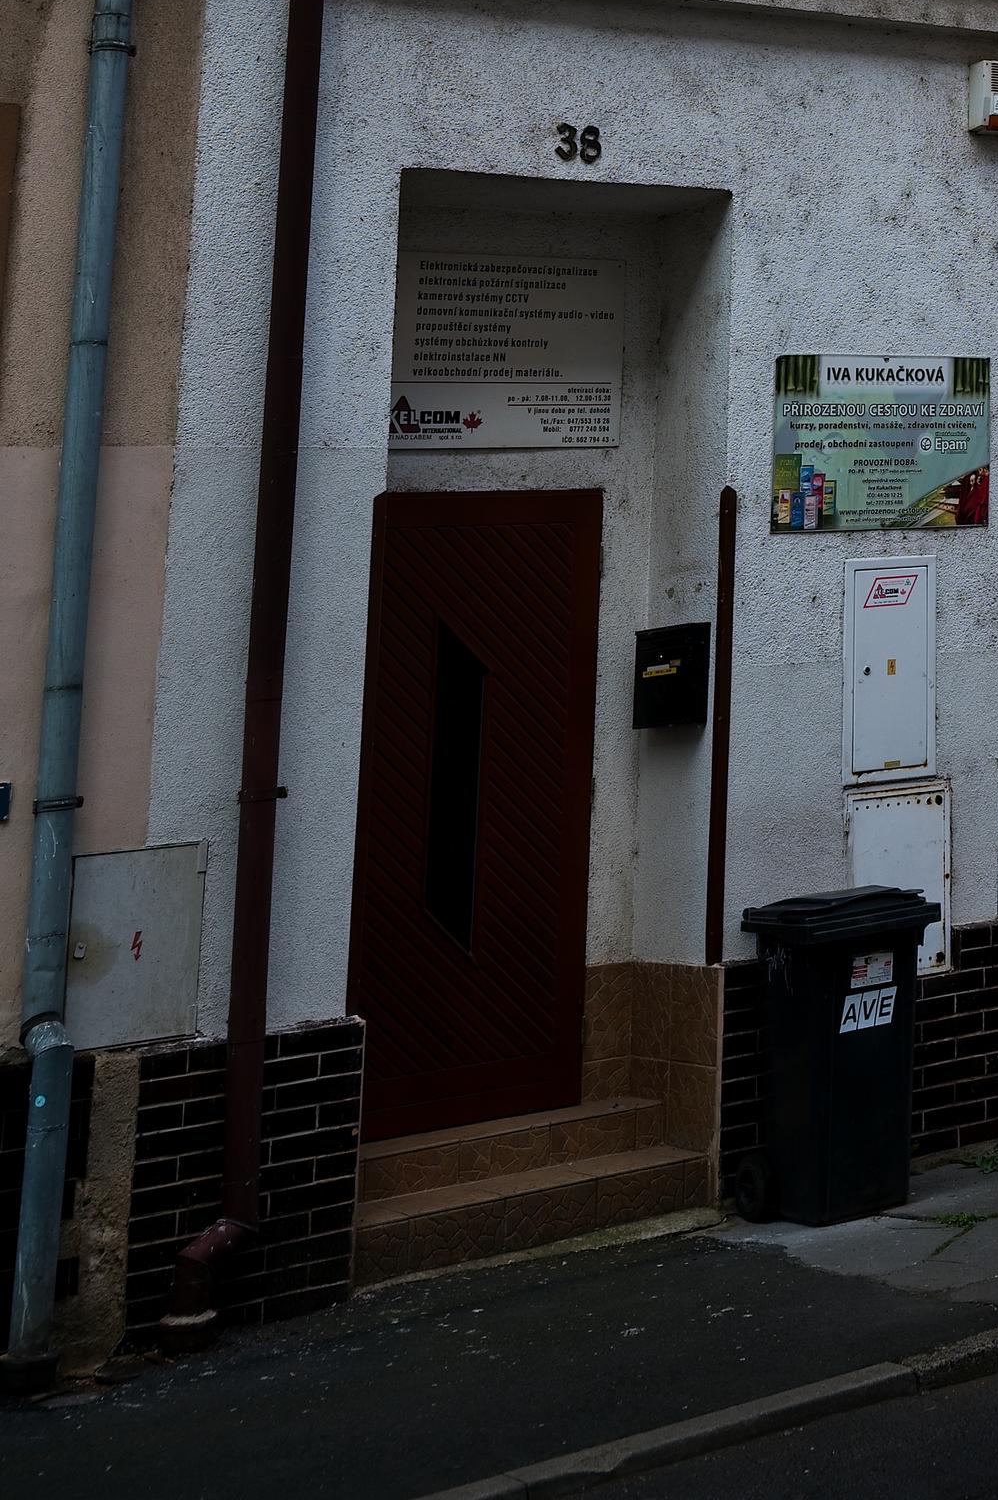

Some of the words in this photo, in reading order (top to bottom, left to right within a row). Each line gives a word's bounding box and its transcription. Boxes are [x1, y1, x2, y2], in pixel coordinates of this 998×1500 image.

[555, 122, 601, 164] 38
[420, 260, 478, 272] Elektronická
[479, 263, 546, 275] zabezpečovací
[547, 266, 598, 277] signalizace
[418, 276, 477, 287] elektronická
[479, 277, 514, 289] požární
[515, 279, 567, 290] signalizace
[417, 291, 464, 301] kamerové
[465, 292, 503, 304] systémy
[505, 293, 529, 303] CCTV
[416, 306, 457, 316] domovní
[459, 307, 518, 318] komunikační
[519, 308, 556, 320] systémy
[558, 310, 583, 320] audio
[590, 311, 615, 320] video
[415, 321, 472, 333] propouštěcí
[473, 322, 511, 334] systémy
[414, 336, 453, 348] systémy
[510, 338, 548, 349] kontroly
[413, 351, 491, 362] elektroinstalace
[493, 352, 506, 362] NN
[412, 366, 481, 377] velkoobchodní
[483, 368, 514, 379] prodej
[515, 368, 563, 378] materiálu.
[826, 367, 851, 381] IVA
[855, 365, 945, 382] KUKAČKOVÁ
[782, 400, 866, 417] PŘIROZENOU
[869, 403, 918, 417] CESTOU
[921, 403, 936, 417] KE
[939, 401, 985, 417] ZDRAVÍ
[790, 421, 817, 431] kurzy,
[818, 420, 871, 431] poradenství,
[872, 420, 906, 430] masáže,
[907, 420, 946, 430] zdravotní
[947, 421, 977, 430] cvičení,
[794, 439, 826, 451] prodej,
[827, 439, 868, 449] obchodní
[868, 440, 914, 450] zastoupení
[934, 436, 968, 454] Epam
[853, 457, 893, 467] PROVOZNÍ
[894, 458, 918, 467] DOBA:
[842, 995, 893, 1026] AVE
